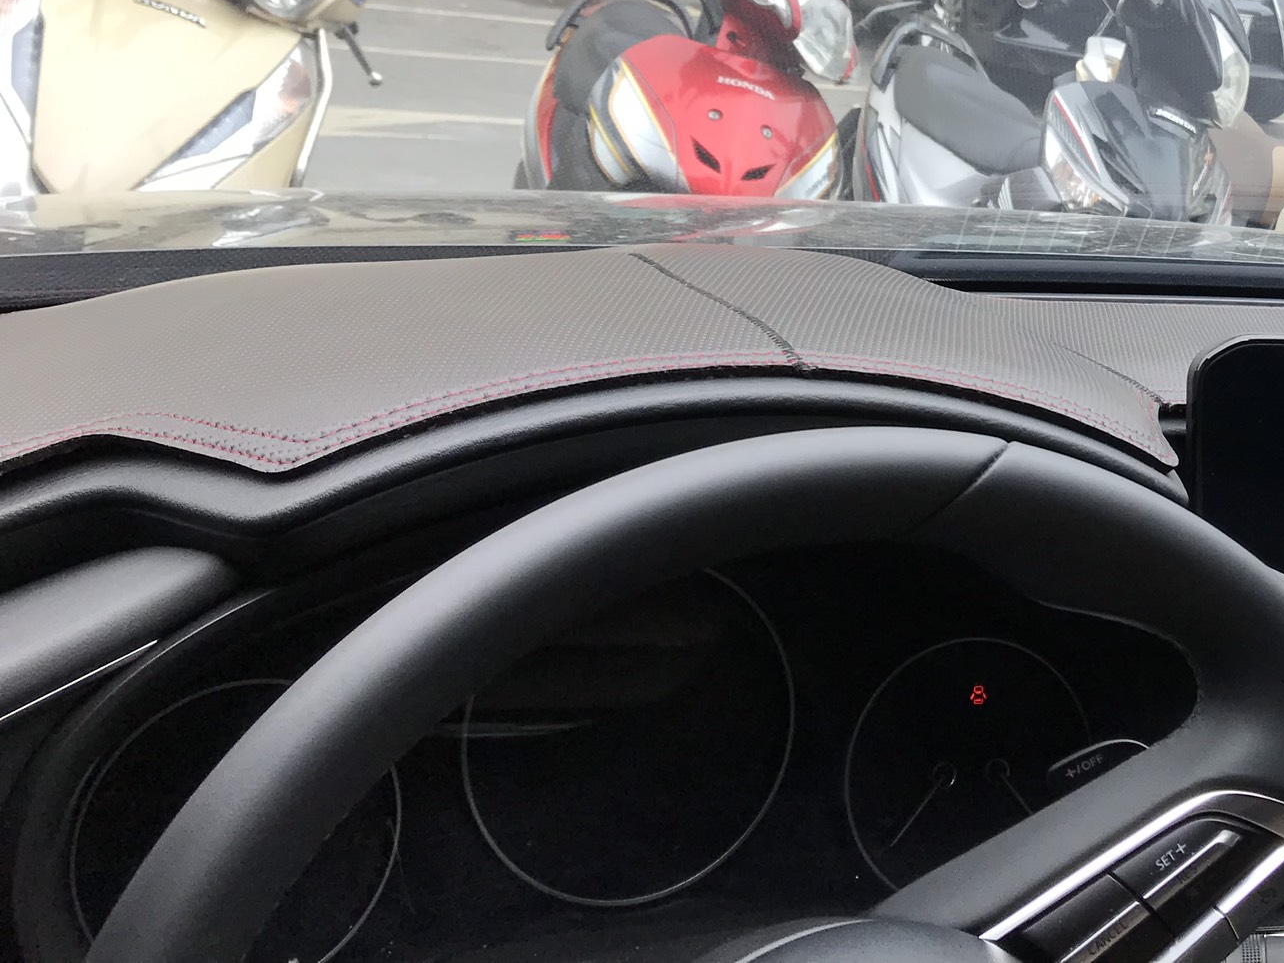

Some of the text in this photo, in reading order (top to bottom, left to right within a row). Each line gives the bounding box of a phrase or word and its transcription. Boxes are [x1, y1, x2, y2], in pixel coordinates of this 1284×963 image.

[717, 76, 775, 101] HONDA
[1155, 108, 1197, 135] HONDA
[1064, 754, 1104, 780] +/OFF
[1088, 921, 1131, 957] CANCEL
